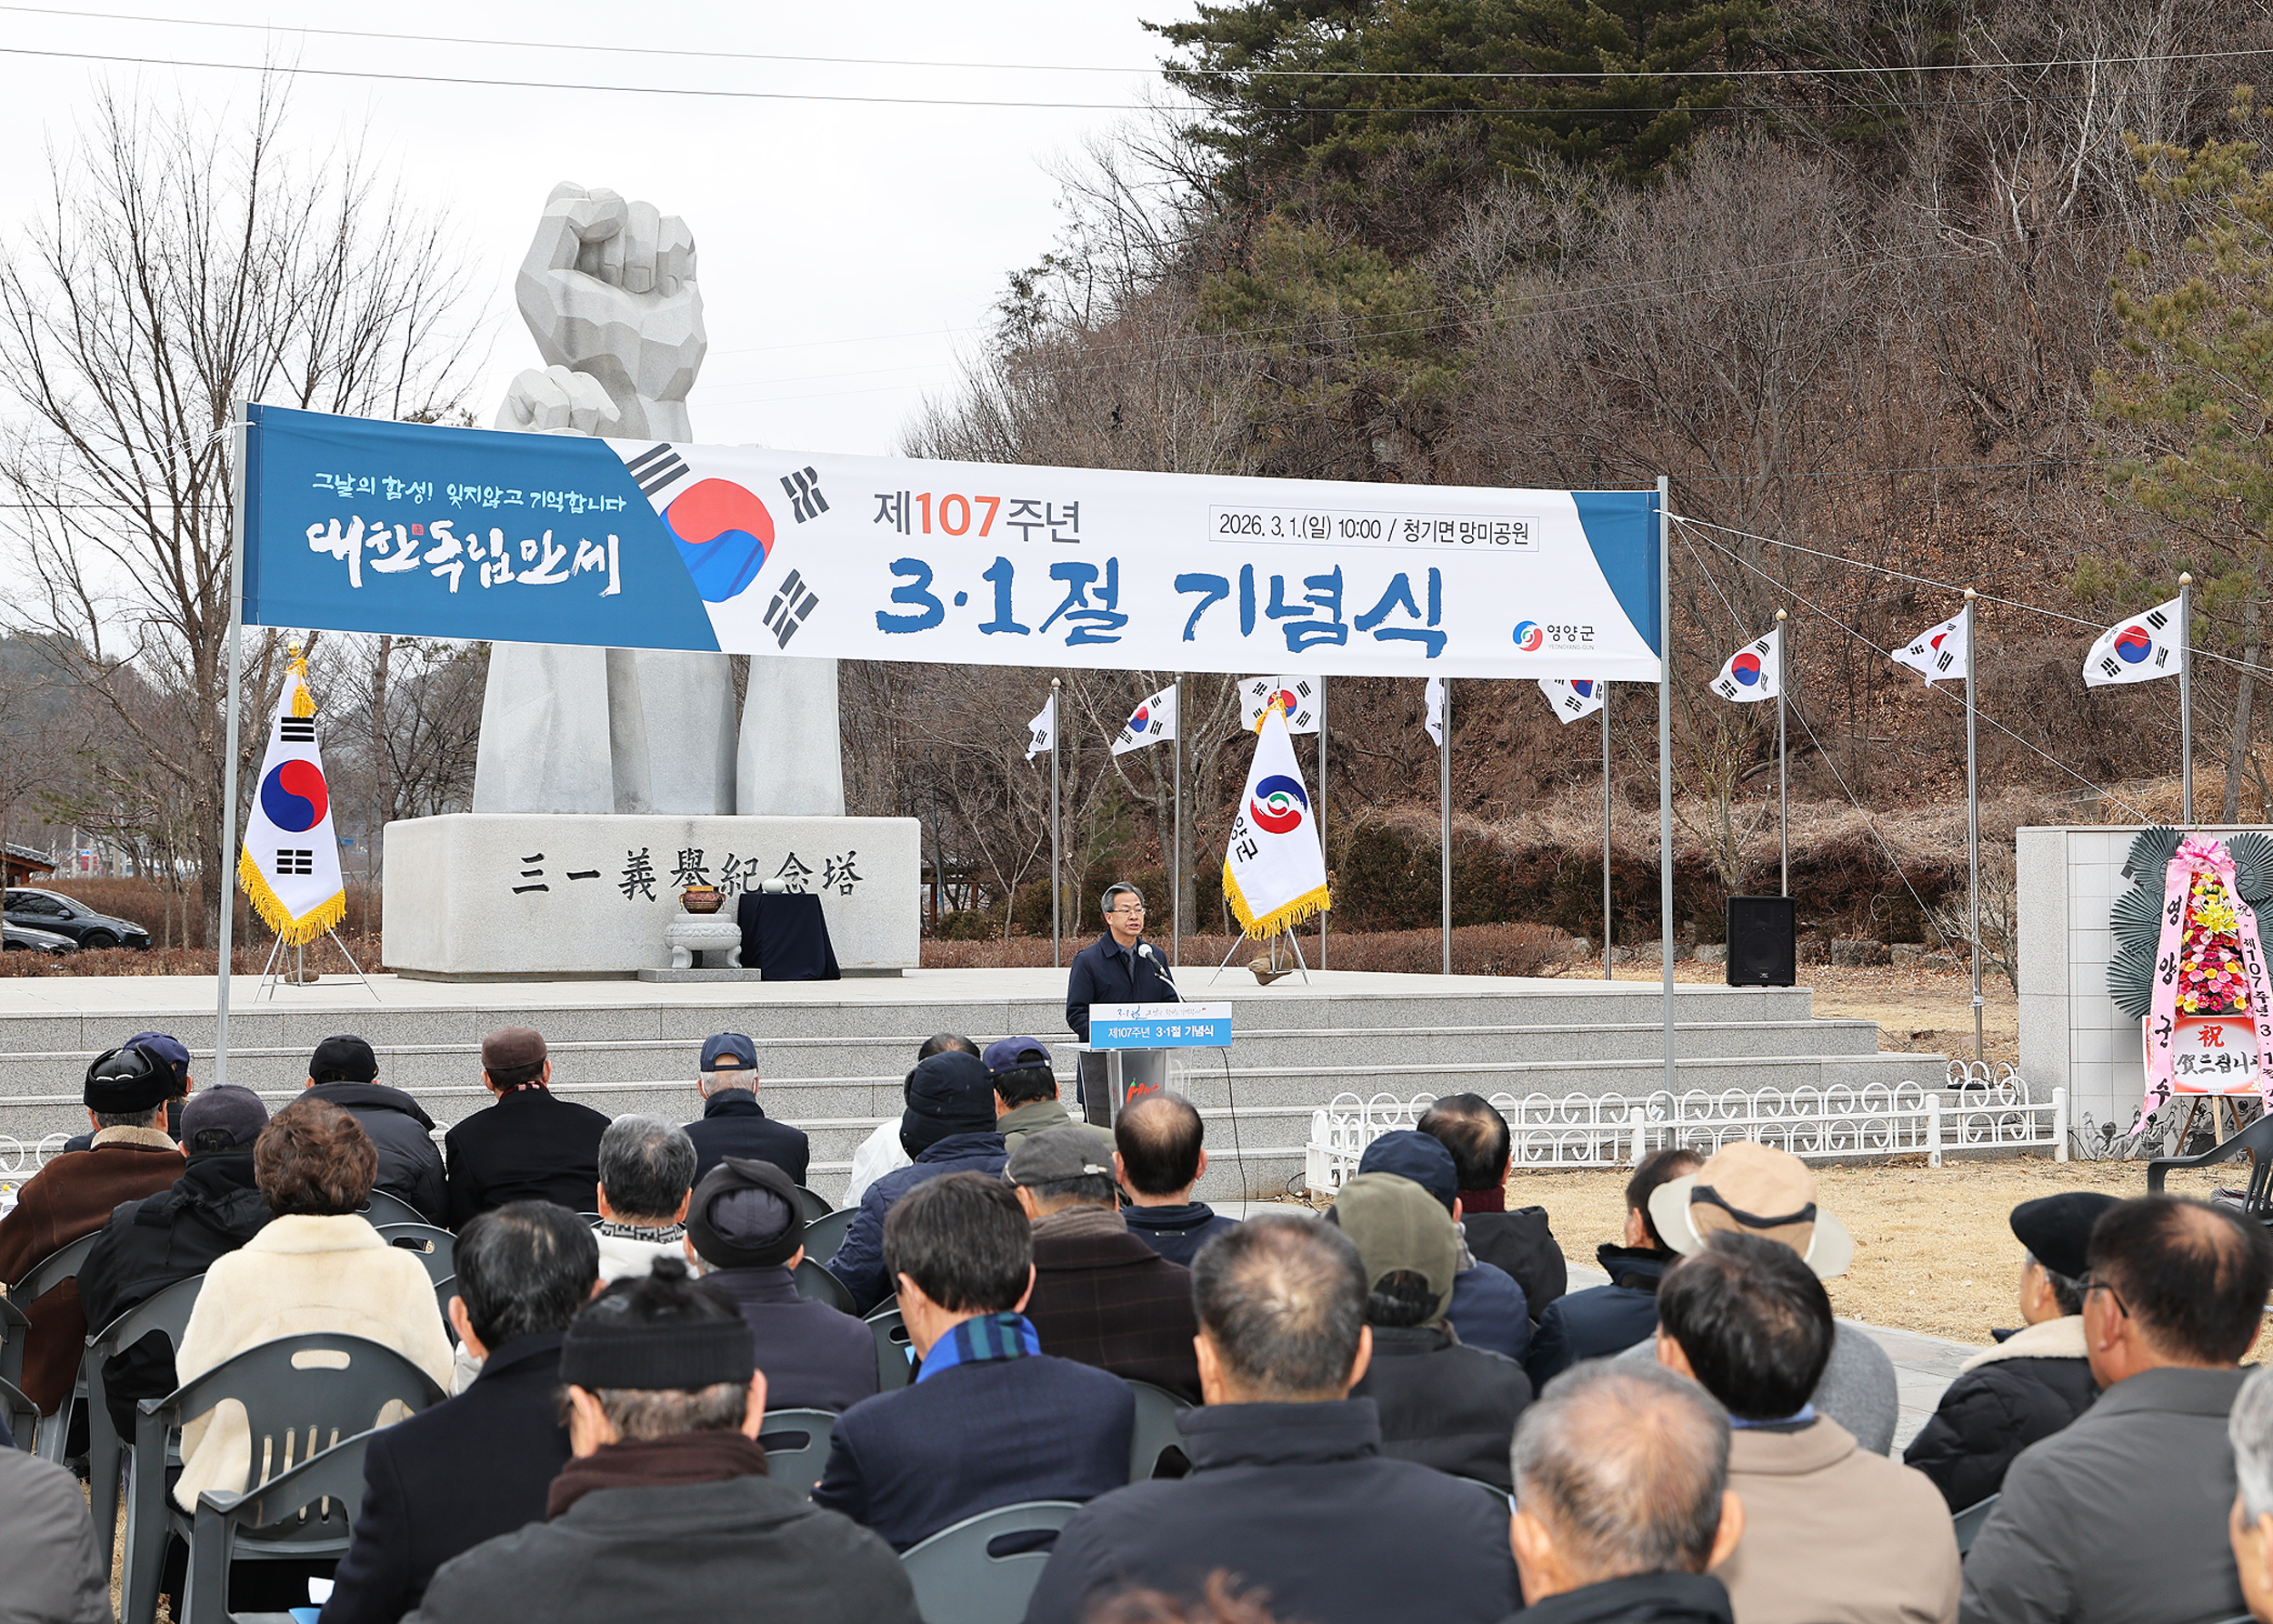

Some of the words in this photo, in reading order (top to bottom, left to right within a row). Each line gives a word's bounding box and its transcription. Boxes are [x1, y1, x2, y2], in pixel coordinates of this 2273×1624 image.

[312, 472, 375, 499] 그날의
[381, 475, 434, 505] 함성!
[446, 482, 525, 509] 잊지않고
[529, 489, 627, 514] 기억합니다
[873, 490, 1080, 544] 제107주년
[1219, 514, 1266, 536] 2026.
[1270, 516, 1285, 537] 3.
[1290, 515, 1332, 540] 1.(일)
[1337, 519, 1381, 539] 10:00
[1387, 518, 1397, 542] /
[1403, 518, 1456, 544] 청기면
[1458, 522, 1529, 546] 망미공원
[305, 515, 621, 597] 대한독립만세
[875, 556, 1128, 647] 3·1절
[1174, 563, 1447, 658] 기념식
[1547, 625, 1595, 642] 영양군
[1107, 1027, 1150, 1038] 제107주년
[1156, 1025, 1182, 1038] 3·1절
[1185, 1025, 1215, 1038] 기념식
[2198, 1025, 2225, 1048] 祝
[2173, 1051, 2258, 1075] 賀드립니
